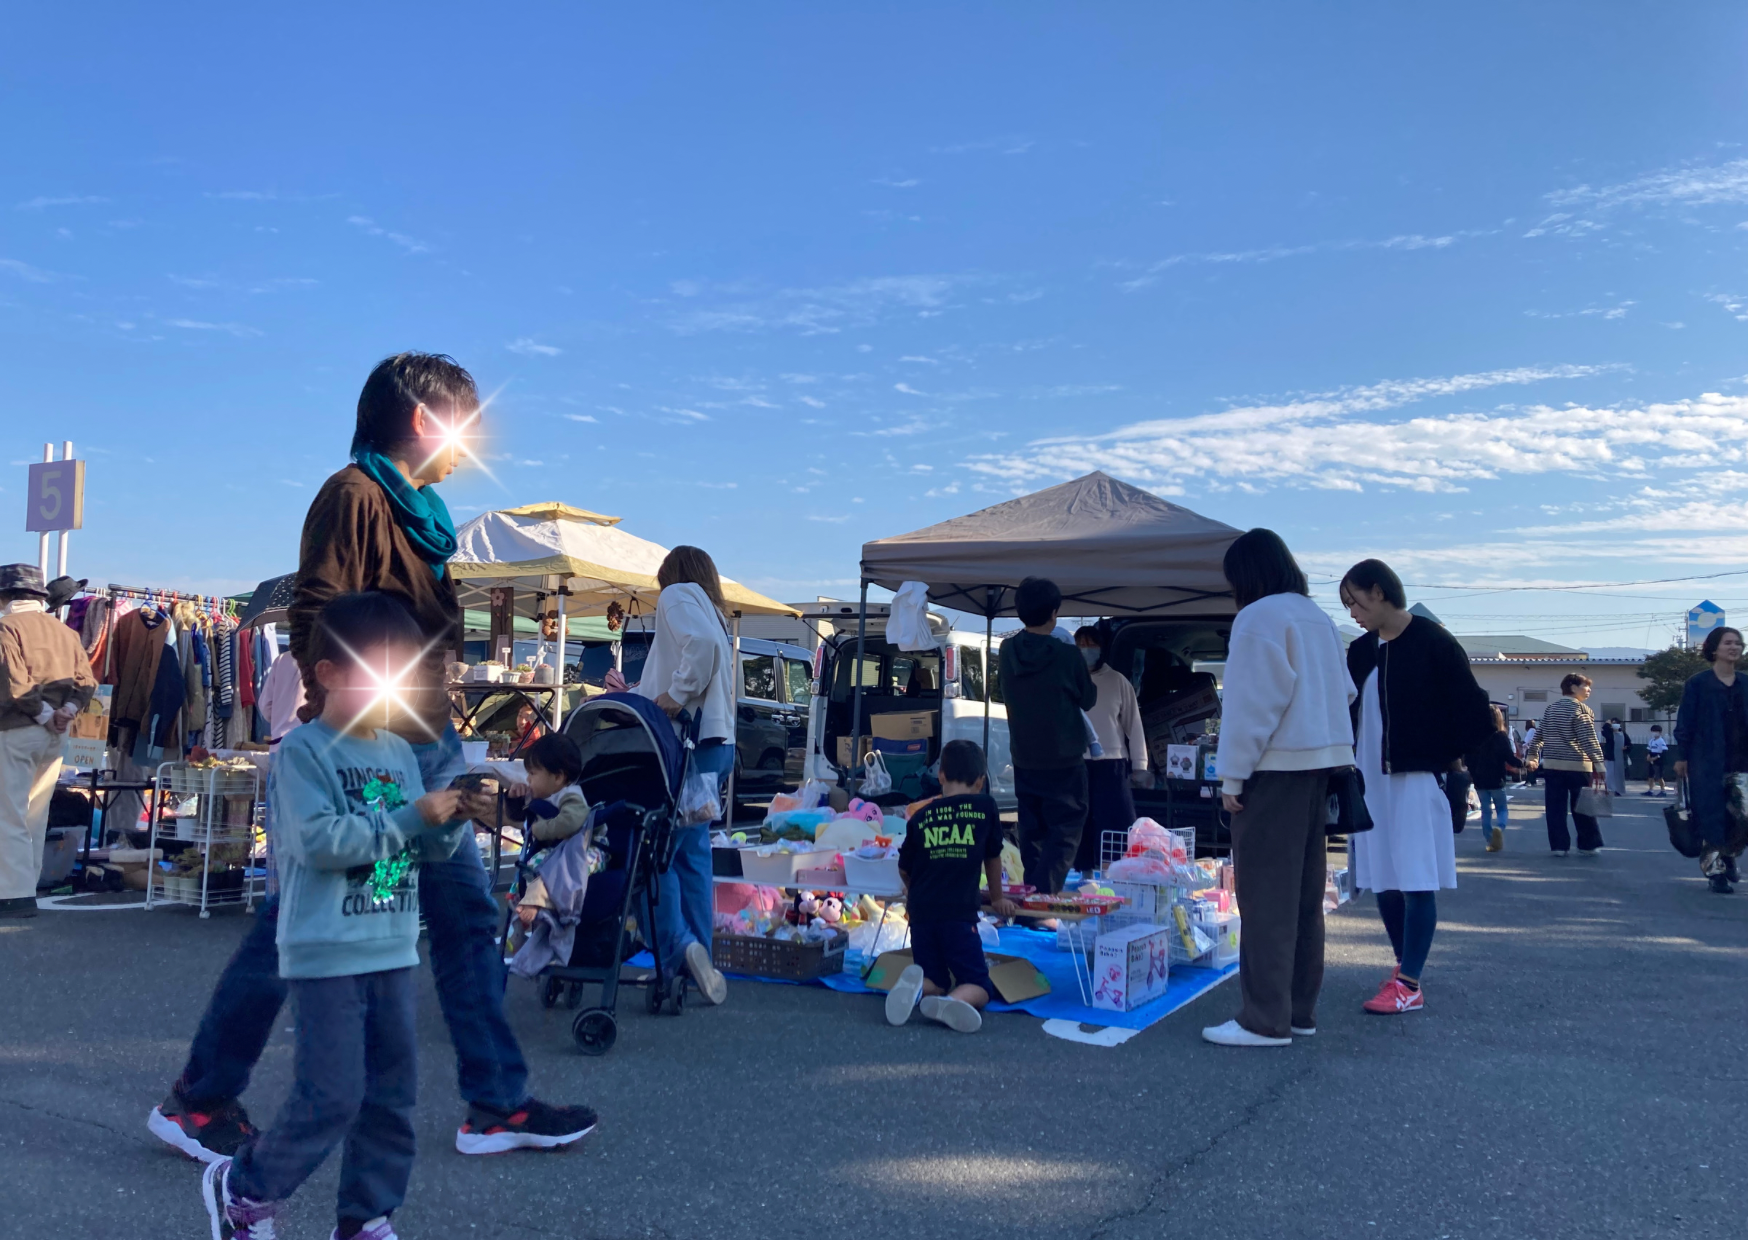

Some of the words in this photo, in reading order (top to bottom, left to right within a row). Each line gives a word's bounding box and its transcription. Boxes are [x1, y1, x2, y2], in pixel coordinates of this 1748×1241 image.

[40, 470, 62, 520] 5
[74, 755, 94, 764] OPEN
[956, 811, 985, 819] FOUNDED
[924, 823, 975, 848] NCAA
[1086, 906, 1101, 914] LED
